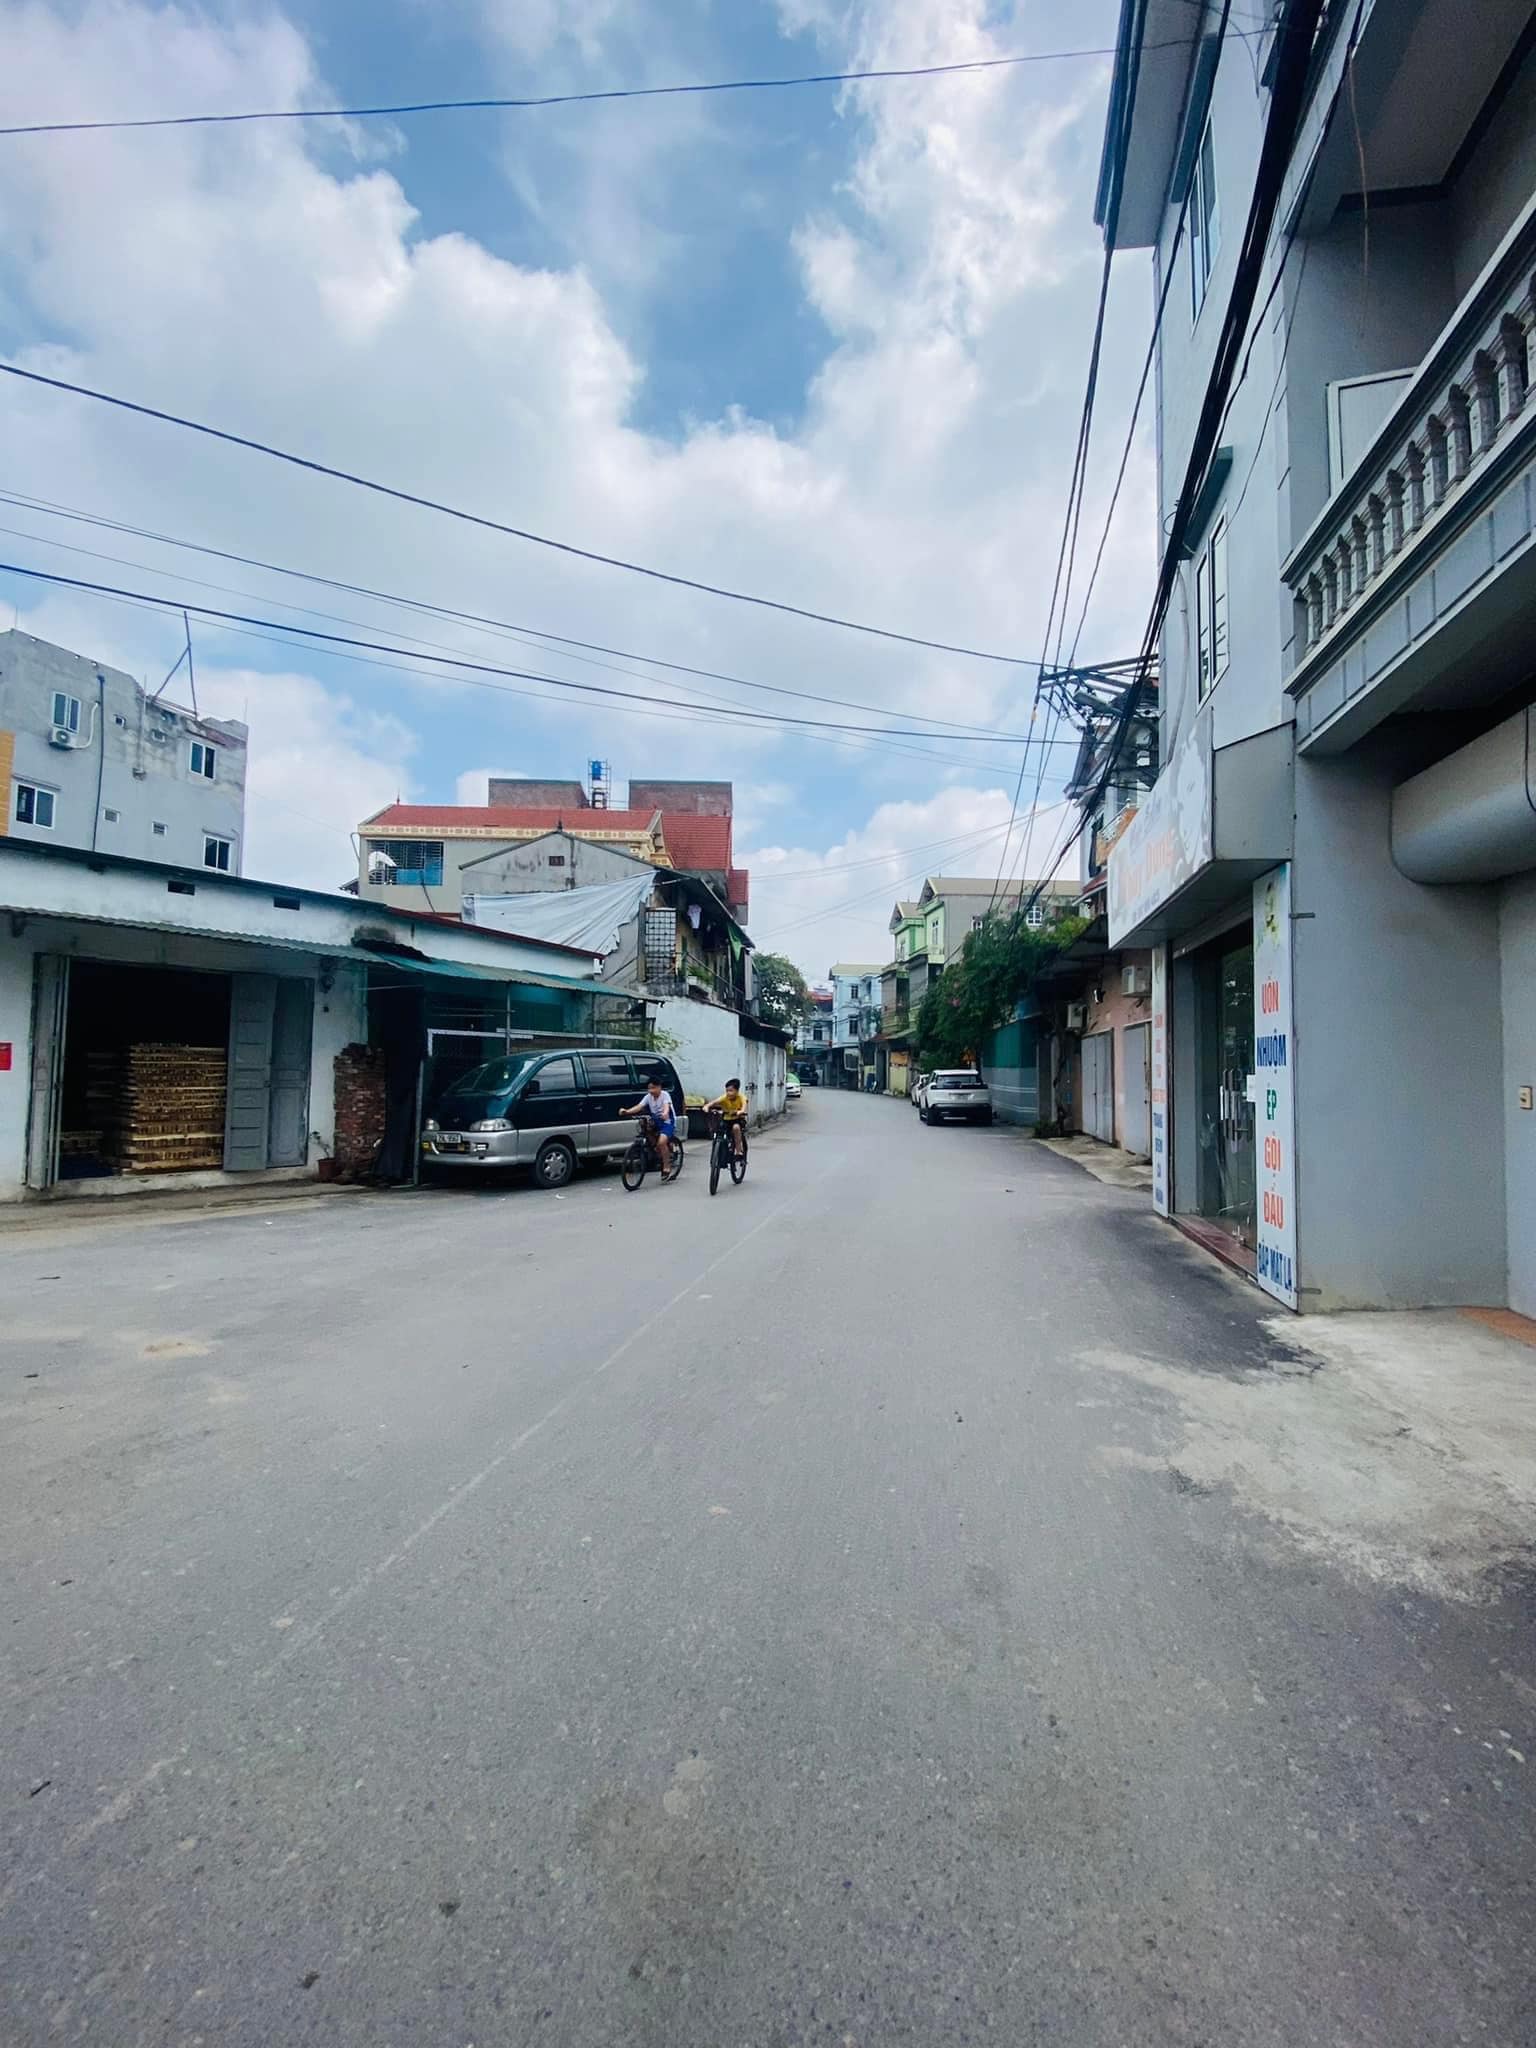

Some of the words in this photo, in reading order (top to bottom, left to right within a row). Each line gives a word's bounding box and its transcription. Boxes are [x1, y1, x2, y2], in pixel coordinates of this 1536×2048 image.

[1257, 1028, 1287, 1074] NHUỘM
[1266, 1082, 1277, 1120] ÉP
[1264, 1131, 1281, 1178] GỘI
